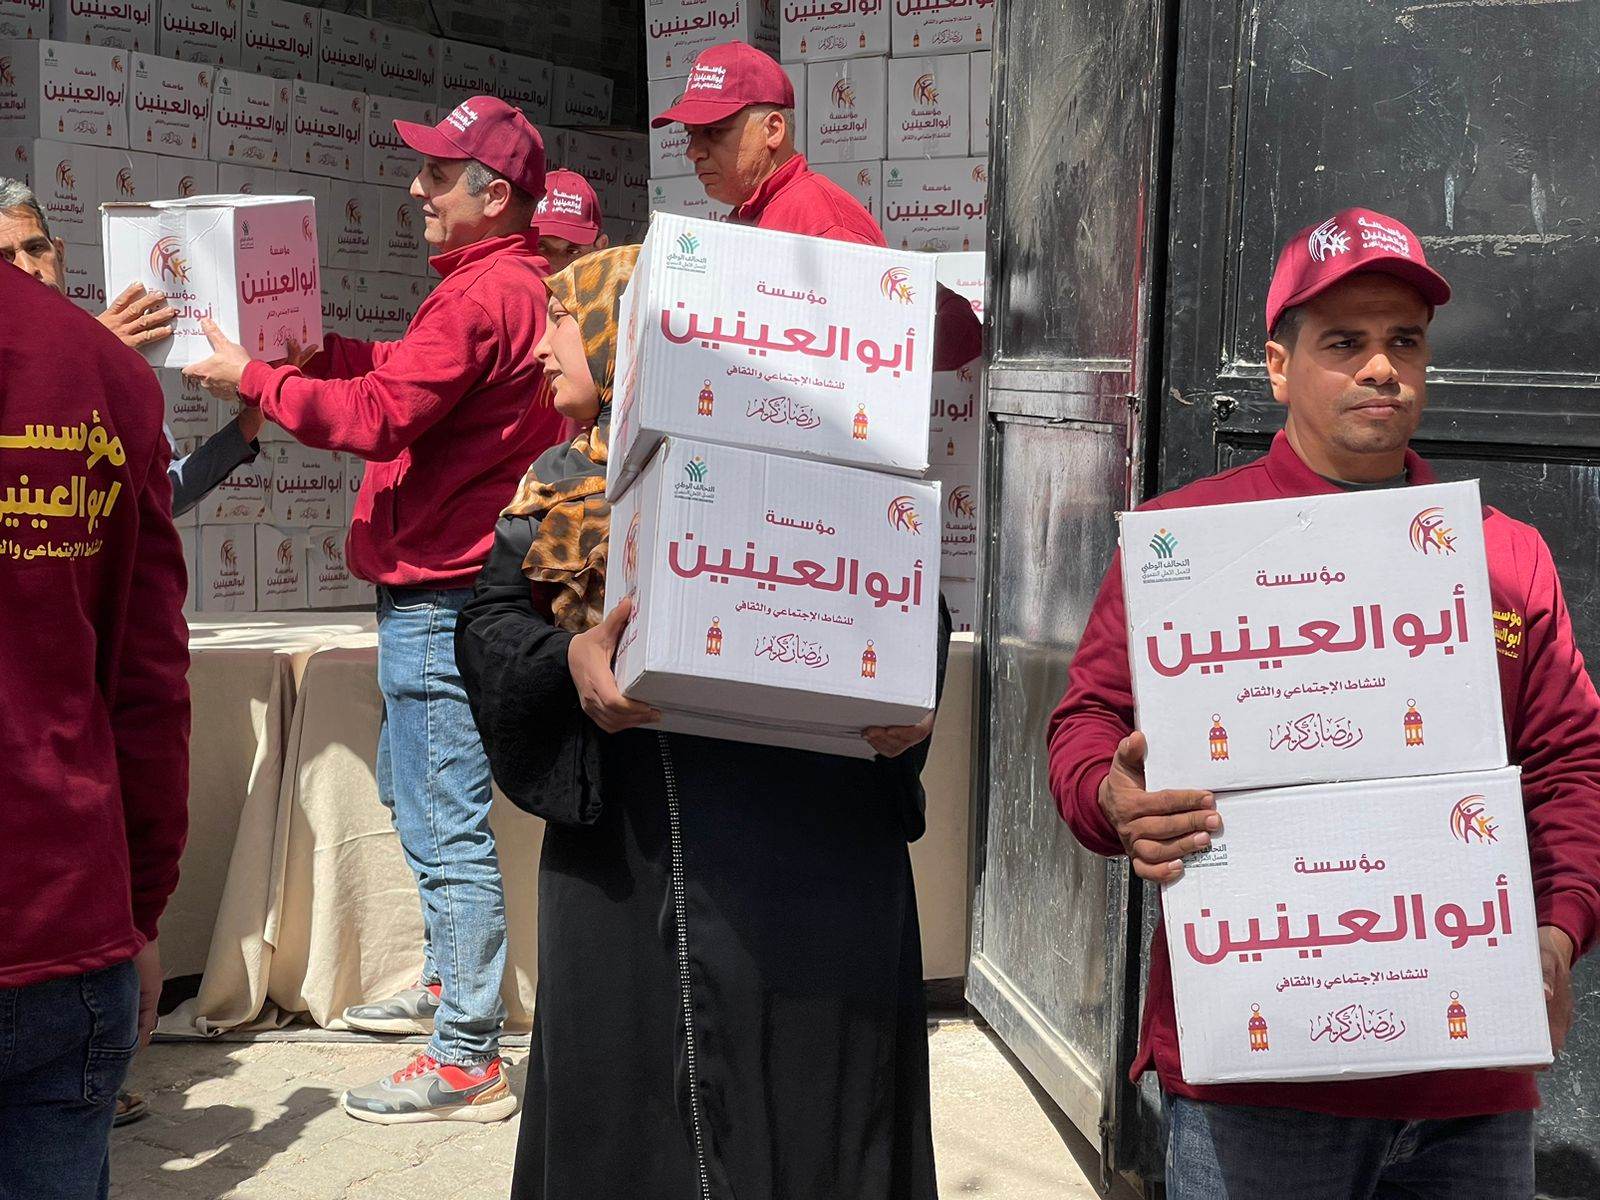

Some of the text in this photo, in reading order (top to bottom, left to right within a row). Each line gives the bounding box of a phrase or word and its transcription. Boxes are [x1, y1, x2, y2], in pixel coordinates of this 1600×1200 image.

[756, 280, 827, 305] مؤسسة
[0, 410, 126, 470] مؤسس
[766, 510, 835, 535] مؤسسة
[1256, 566, 1346, 587] مؤسسة
[1294, 853, 1386, 874] مؤسسة
